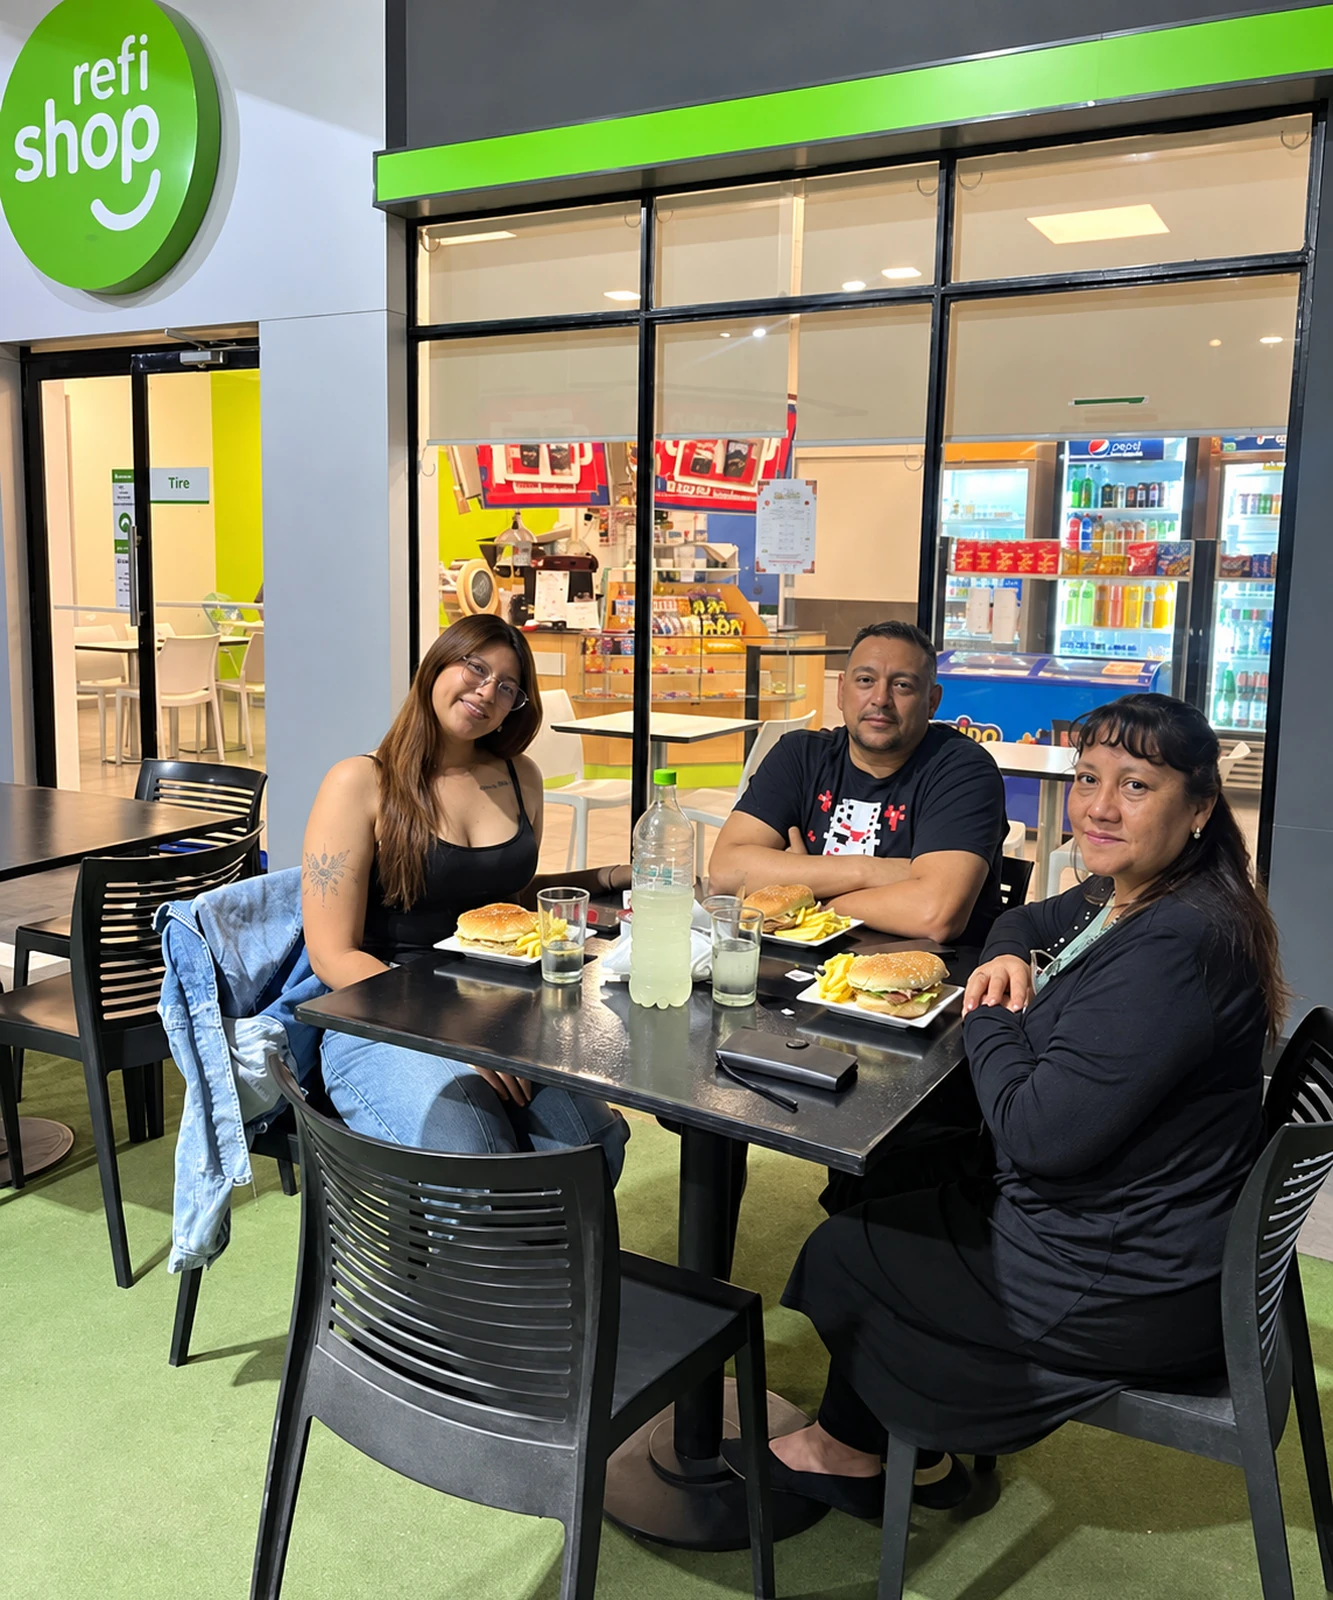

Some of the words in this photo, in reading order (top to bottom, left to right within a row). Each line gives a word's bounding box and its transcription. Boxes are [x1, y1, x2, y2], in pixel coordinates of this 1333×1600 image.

[73, 33, 149, 106] refi
[14, 98, 161, 184] shop
[168, 477, 190, 489] Tire
